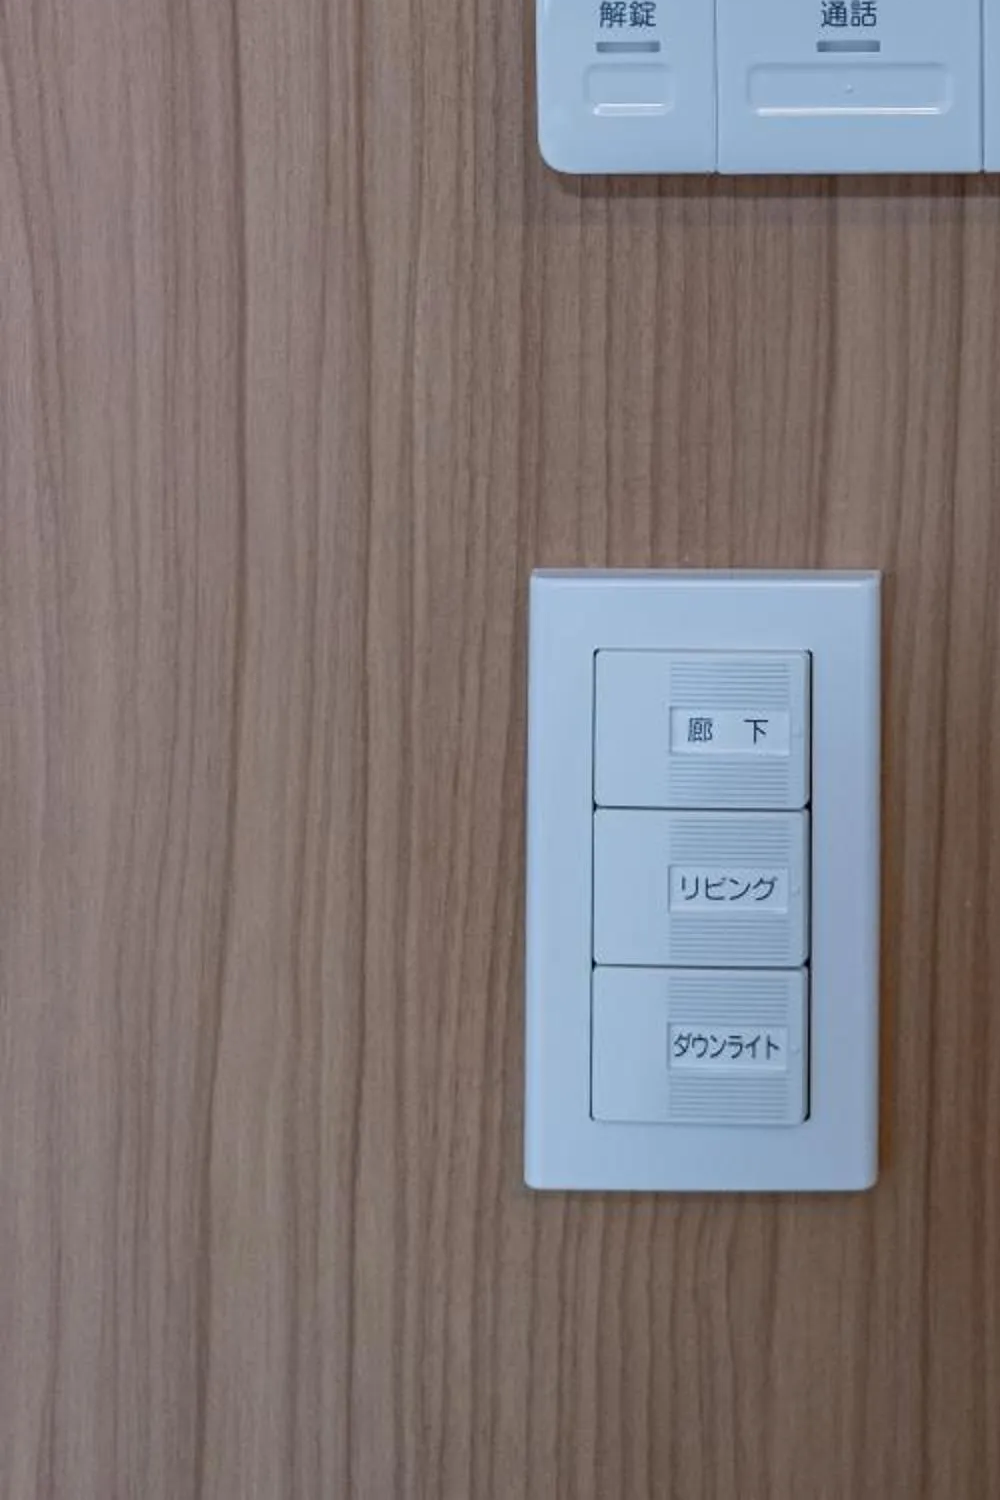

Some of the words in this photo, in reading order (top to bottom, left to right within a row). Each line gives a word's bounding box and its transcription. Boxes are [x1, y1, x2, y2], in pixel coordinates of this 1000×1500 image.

[599, 0, 657, 29] 解錠
[820, 0, 878, 28] 通話
[680, 875, 779, 902] リビング
[673, 1032, 781, 1062] ダウンライト
